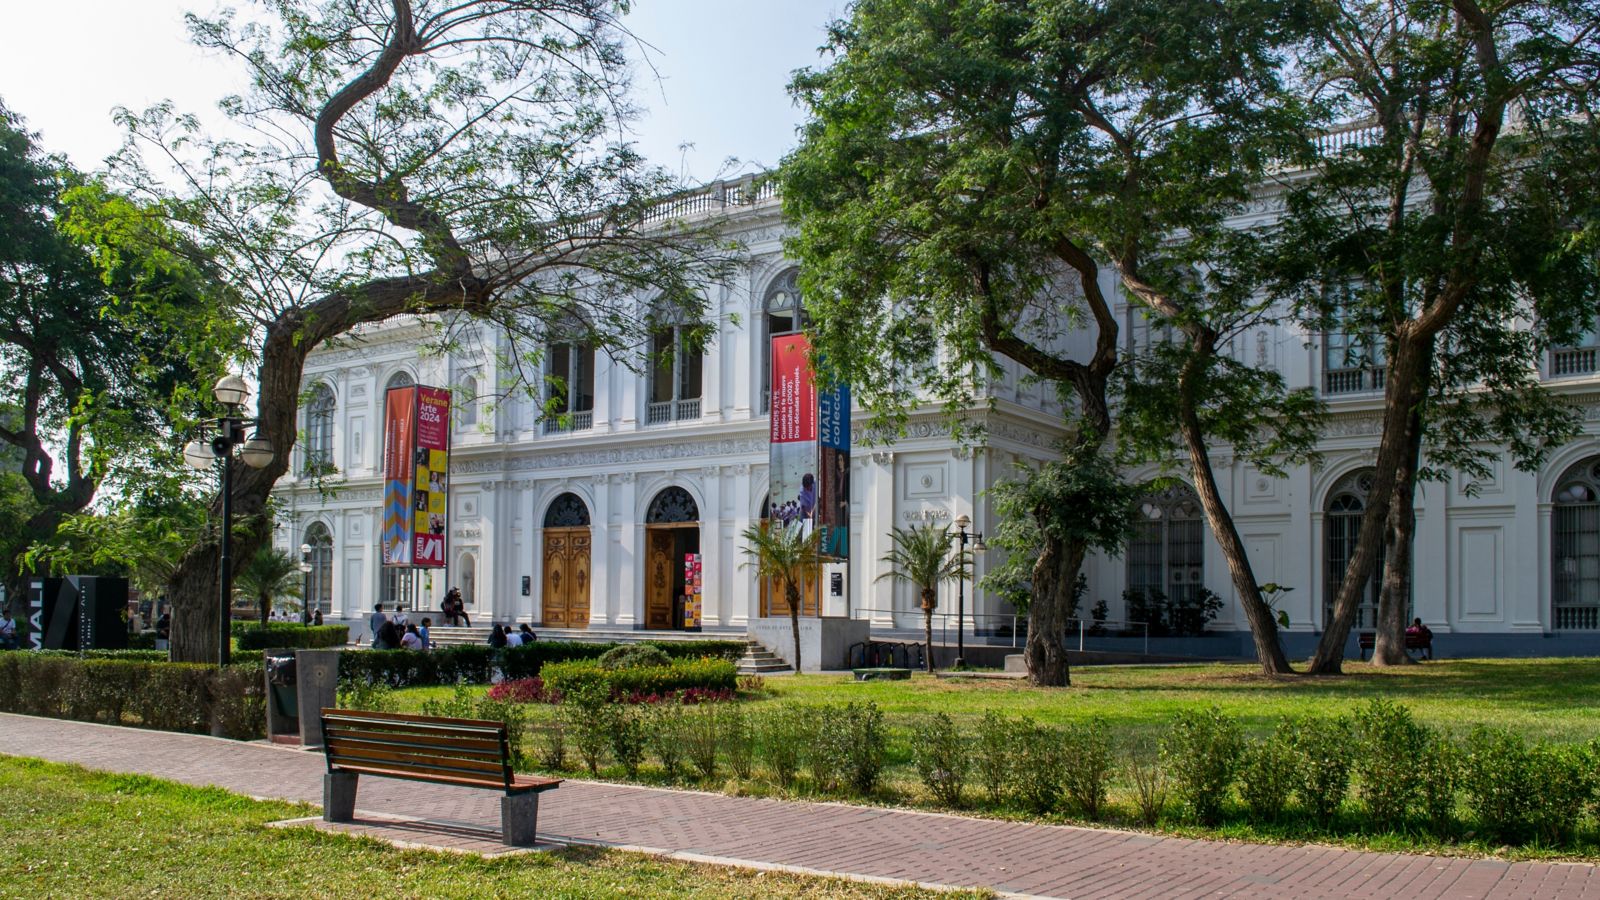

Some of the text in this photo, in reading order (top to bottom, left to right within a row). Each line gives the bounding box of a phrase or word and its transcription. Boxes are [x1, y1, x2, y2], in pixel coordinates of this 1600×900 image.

[420, 402, 437, 414] Arte
[420, 412, 440, 423] 2024
[822, 399, 830, 443] MALI
[832, 388, 840, 446] colecci
[30, 582, 42, 651] MALI
